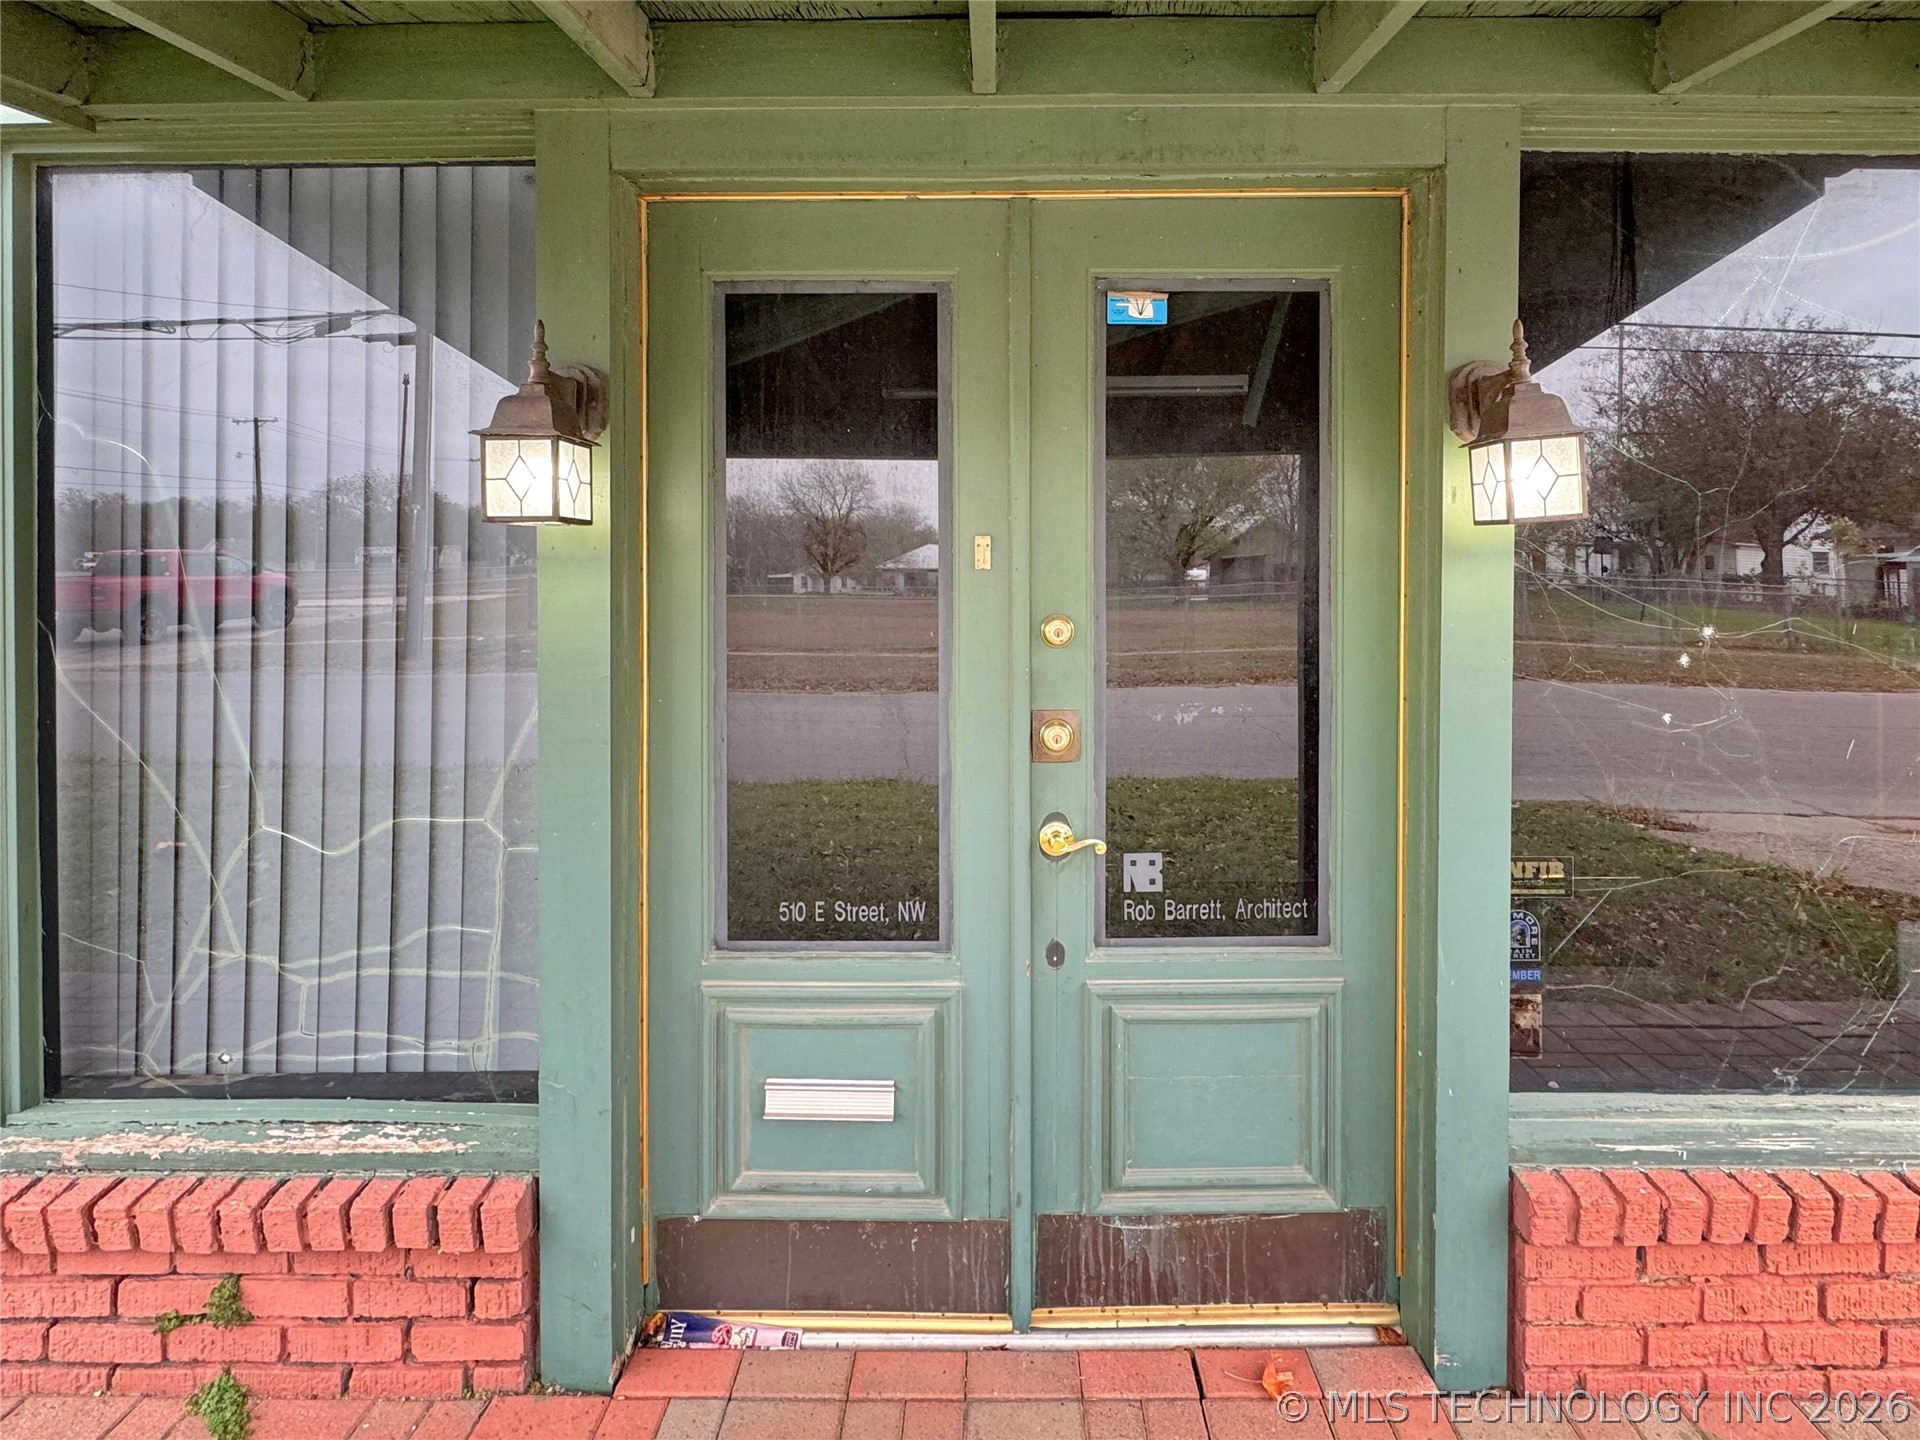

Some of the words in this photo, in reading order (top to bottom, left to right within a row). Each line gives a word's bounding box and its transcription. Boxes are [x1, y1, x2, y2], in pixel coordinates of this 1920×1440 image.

[779, 901, 806, 923] 510
[815, 901, 825, 922] E
[834, 900, 889, 926] Street,
[898, 901, 926, 922] NW
[1123, 899, 1155, 922] Rob
[1164, 899, 1226, 922] Barrett,
[1235, 897, 1308, 920] Architect
